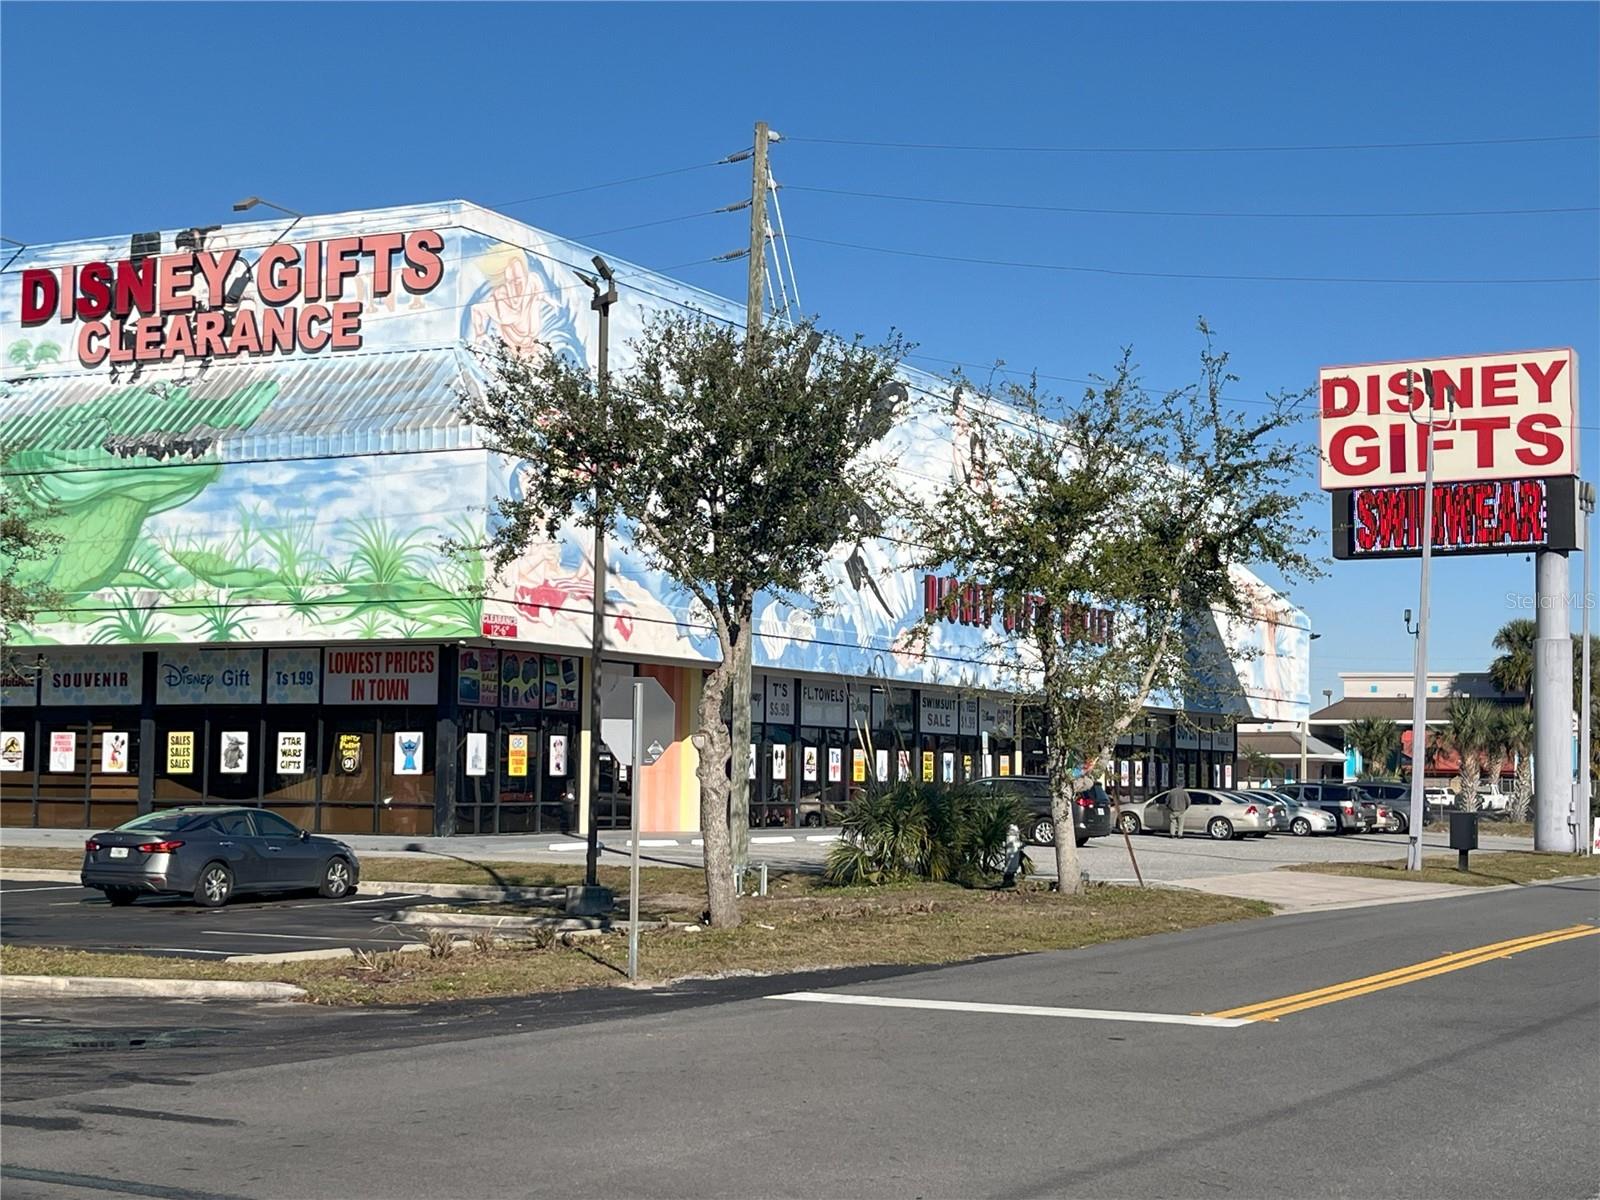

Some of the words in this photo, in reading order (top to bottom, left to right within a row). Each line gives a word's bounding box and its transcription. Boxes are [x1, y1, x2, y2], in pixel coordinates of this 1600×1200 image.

[21, 249, 238, 328] DISNEY
[257, 229, 444, 307] GIFTS
[78, 302, 363, 369] CLEARANCE
[1322, 360, 1567, 419] DISNEY
[1329, 413, 1563, 476] GIFTS
[328, 652, 382, 674] LOWEST
[385, 651, 434, 673] PRICES
[53, 672, 128, 688] SOUVENIR
[222, 669, 250, 687] Gift
[275, 672, 288, 686] Ts
[291, 671, 313, 686] 1.99
[351, 679, 365, 701] IN
[368, 679, 409, 701] TOWN
[773, 682, 788, 697] T'S
[922, 696, 956, 711] SWIMSUIT
[927, 713, 951, 728] SALE
[170, 735, 191, 745] SALES
[281, 737, 302, 746] STAR
[170, 747, 191, 757] SALES
[281, 749, 302, 758] WARS
[170, 759, 190, 769] SALES
[280, 760, 301, 769] GIFTS
